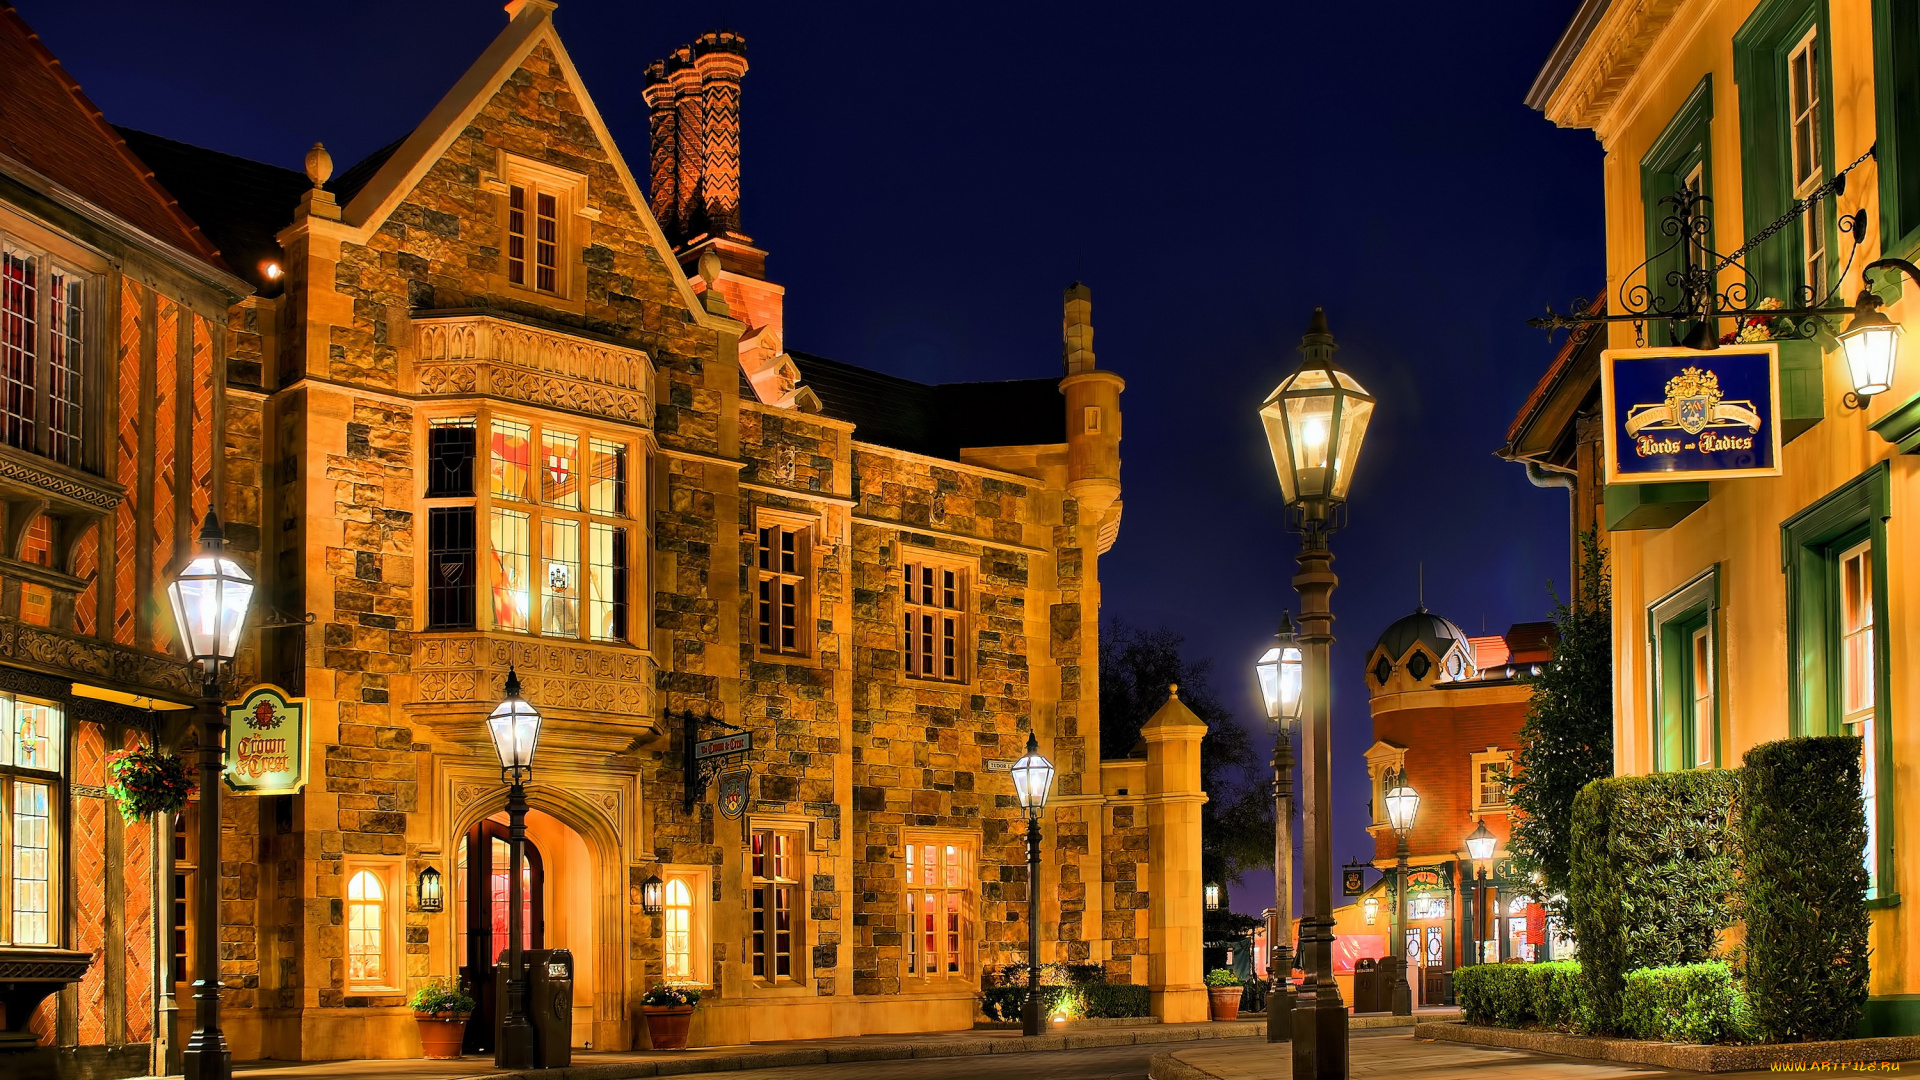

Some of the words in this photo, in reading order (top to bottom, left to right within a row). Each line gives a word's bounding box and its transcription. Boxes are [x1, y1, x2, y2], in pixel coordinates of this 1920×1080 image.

[1636, 435, 1681, 457] Lords
[1699, 431, 1753, 455] Ladies
[238, 737, 286, 759] Crown
[708, 743, 724, 754] Crown
[730, 738, 744, 750] Crest
[236, 760, 248, 775] &
[248, 754, 290, 778] Crest
[1407, 872, 1438, 887] PUB
